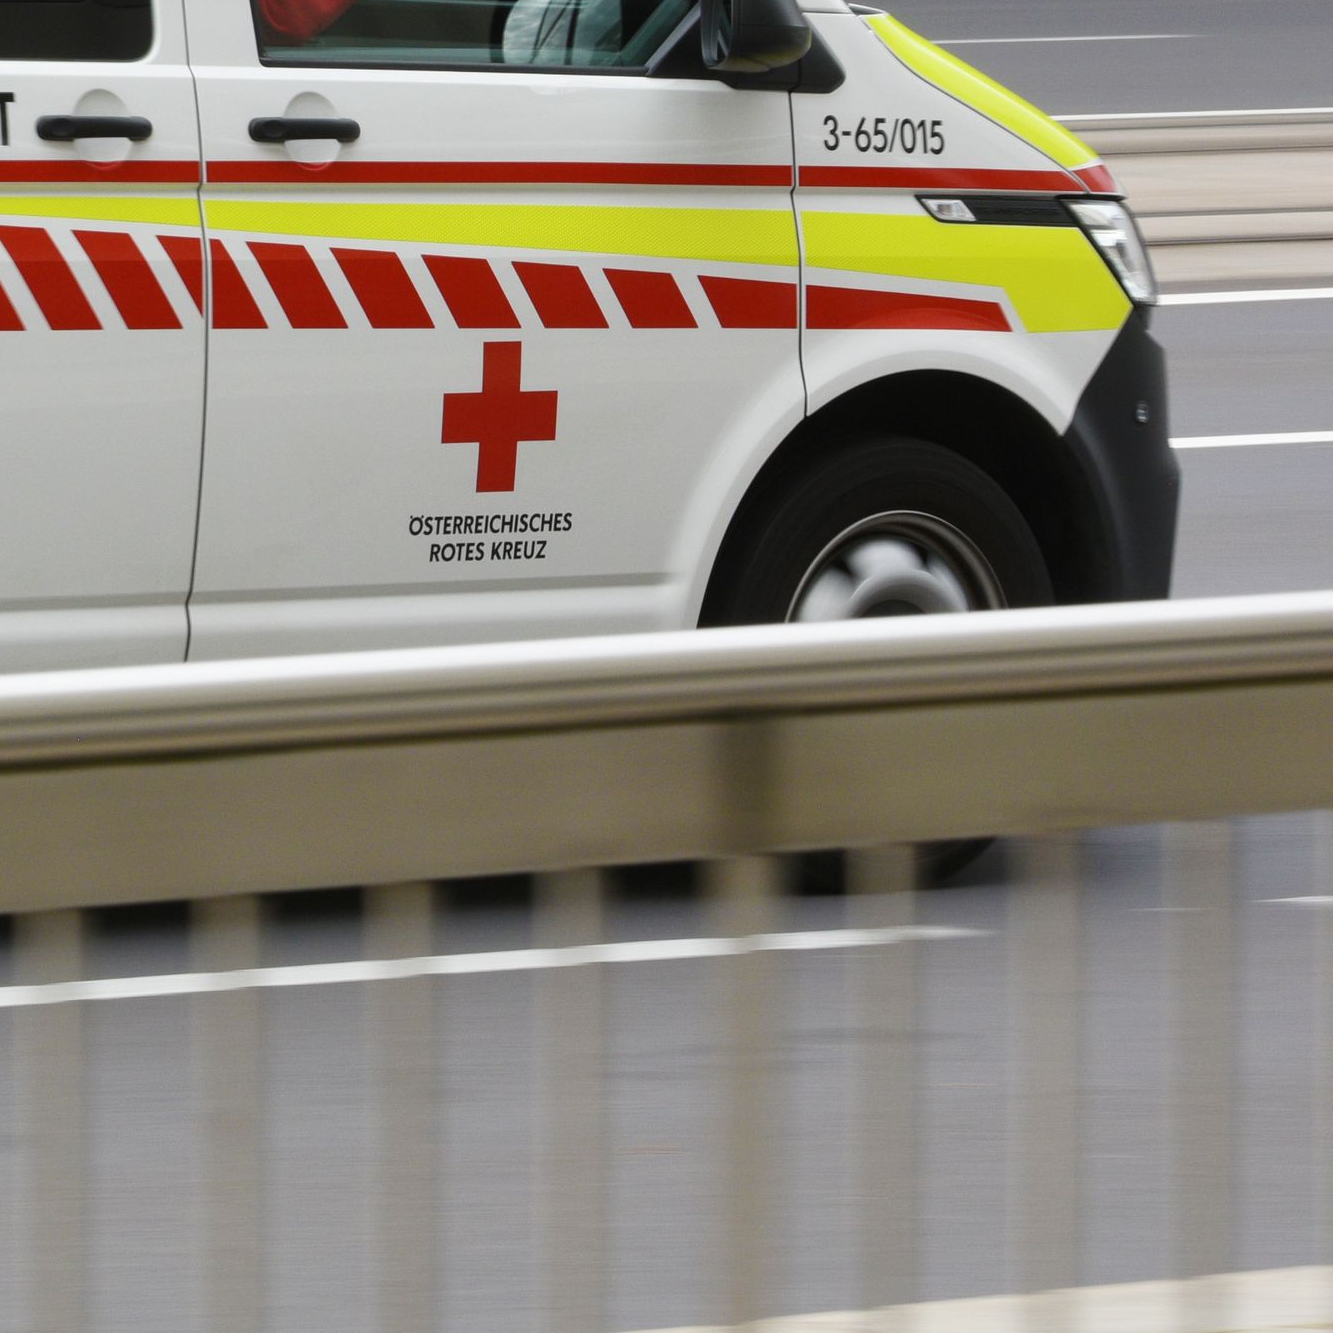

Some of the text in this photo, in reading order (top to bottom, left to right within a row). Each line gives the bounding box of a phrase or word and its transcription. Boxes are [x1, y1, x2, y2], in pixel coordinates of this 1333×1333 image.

[823, 115, 945, 155] 3-65/015
[408, 512, 573, 536] ÖSTERREICHISCHES
[429, 540, 547, 563] ROTES KREUZ
